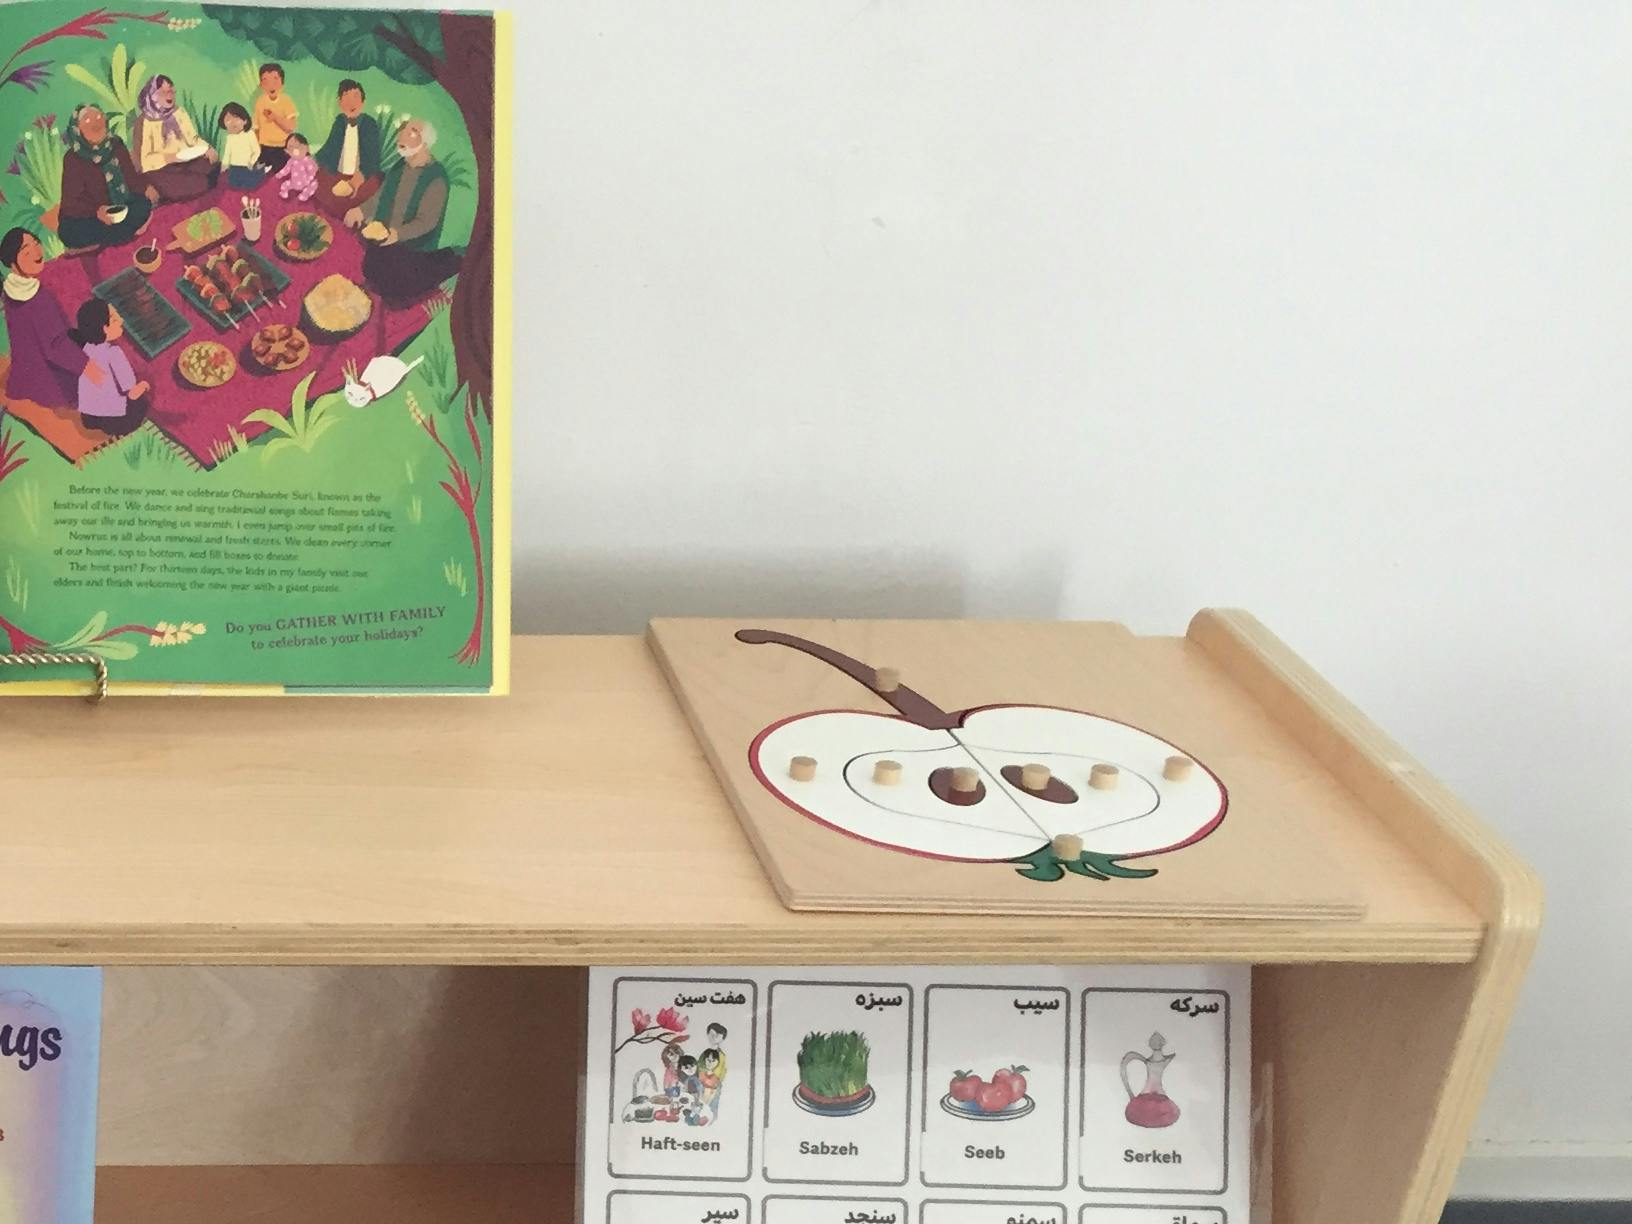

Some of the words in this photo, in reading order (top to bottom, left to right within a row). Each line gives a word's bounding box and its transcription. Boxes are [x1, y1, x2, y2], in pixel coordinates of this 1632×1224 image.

[69, 485, 100, 495] Before
[104, 486, 119, 495] the
[187, 486, 229, 498] celebrate
[318, 491, 349, 501] known
[366, 493, 381, 502] the
[54, 501, 88, 510] festival
[91, 501, 100, 510] of
[125, 502, 141, 511] We
[145, 503, 173, 512] dance
[176, 503, 192, 512] and
[196, 503, 215, 515] sing
[218, 505, 266, 514] traditional
[269, 508, 295, 517] songs
[298, 507, 325, 515] about
[328, 506, 359, 516] flames
[362, 508, 391, 518] taking
[54, 518, 77, 527] away
[118, 518, 135, 526] and
[138, 517, 177, 529] bringing
[268, 523, 292, 533] jump
[319, 523, 343, 531] small
[367, 524, 376, 532] of
[69, 531, 107, 541] Nowruz
[110, 533, 118, 541] is
[121, 532, 132, 541] all
[136, 533, 161, 542] about
[165, 534, 202, 543] renewal
[205, 536, 222, 544] and
[226, 536, 249, 544] fresh
[285, 537, 300, 546] We
[304, 537, 328, 547] clean
[331, 540, 357, 548] every
[360, 540, 392, 548] corner
[54, 547, 63, 556] of
[86, 547, 115, 557] home,
[119, 550, 134, 559] top
[149, 548, 186, 559] bottom,
[189, 550, 206, 558] and
[210, 550, 222, 560] fill
[224, 551, 251, 560] boxes
[254, 552, 263, 560] to
[69, 562, 87, 571] The
[91, 563, 110, 571] best
[113, 563, 137, 573] part?
[140, 563, 156, 573] For
[160, 564, 197, 574] thirteen
[227, 567, 242, 575] the
[245, 566, 265, 576] kids
[268, 567, 277, 576] in
[280, 569, 294, 578] my
[298, 567, 326, 578] family
[329, 569, 348, 577] visit
[53, 577, 82, 587] elders
[85, 578, 103, 587] and
[107, 577, 133, 588] finish
[136, 579, 187, 590] welcoming
[190, 580, 205, 589] the
[231, 584, 250, 592] year
[254, 583, 275, 591] with
[286, 583, 309, 593] giant
[225, 622, 244, 633] Do
[248, 624, 272, 634] you
[276, 615, 337, 631] GATHER
[341, 612, 384, 625] WITH
[390, 606, 446, 622] FAMILY
[251, 640, 264, 650] to
[269, 635, 327, 648] celebrate
[331, 633, 359, 647] your
[364, 626, 423, 641] holidays?
[674, 992, 708, 1008] سین
[709, 991, 746, 1006] هفت
[855, 992, 903, 1010] سبزه
[1013, 997, 1060, 1014] سیب
[1170, 997, 1220, 1016] سرکه
[641, 1136, 721, 1152] Haft-seen
[799, 1141, 859, 1156] Sabzeh
[964, 1145, 1005, 1160] Seeb
[1123, 1149, 1182, 1164] Serkeh
[701, 1208, 739, 1224] سیر
